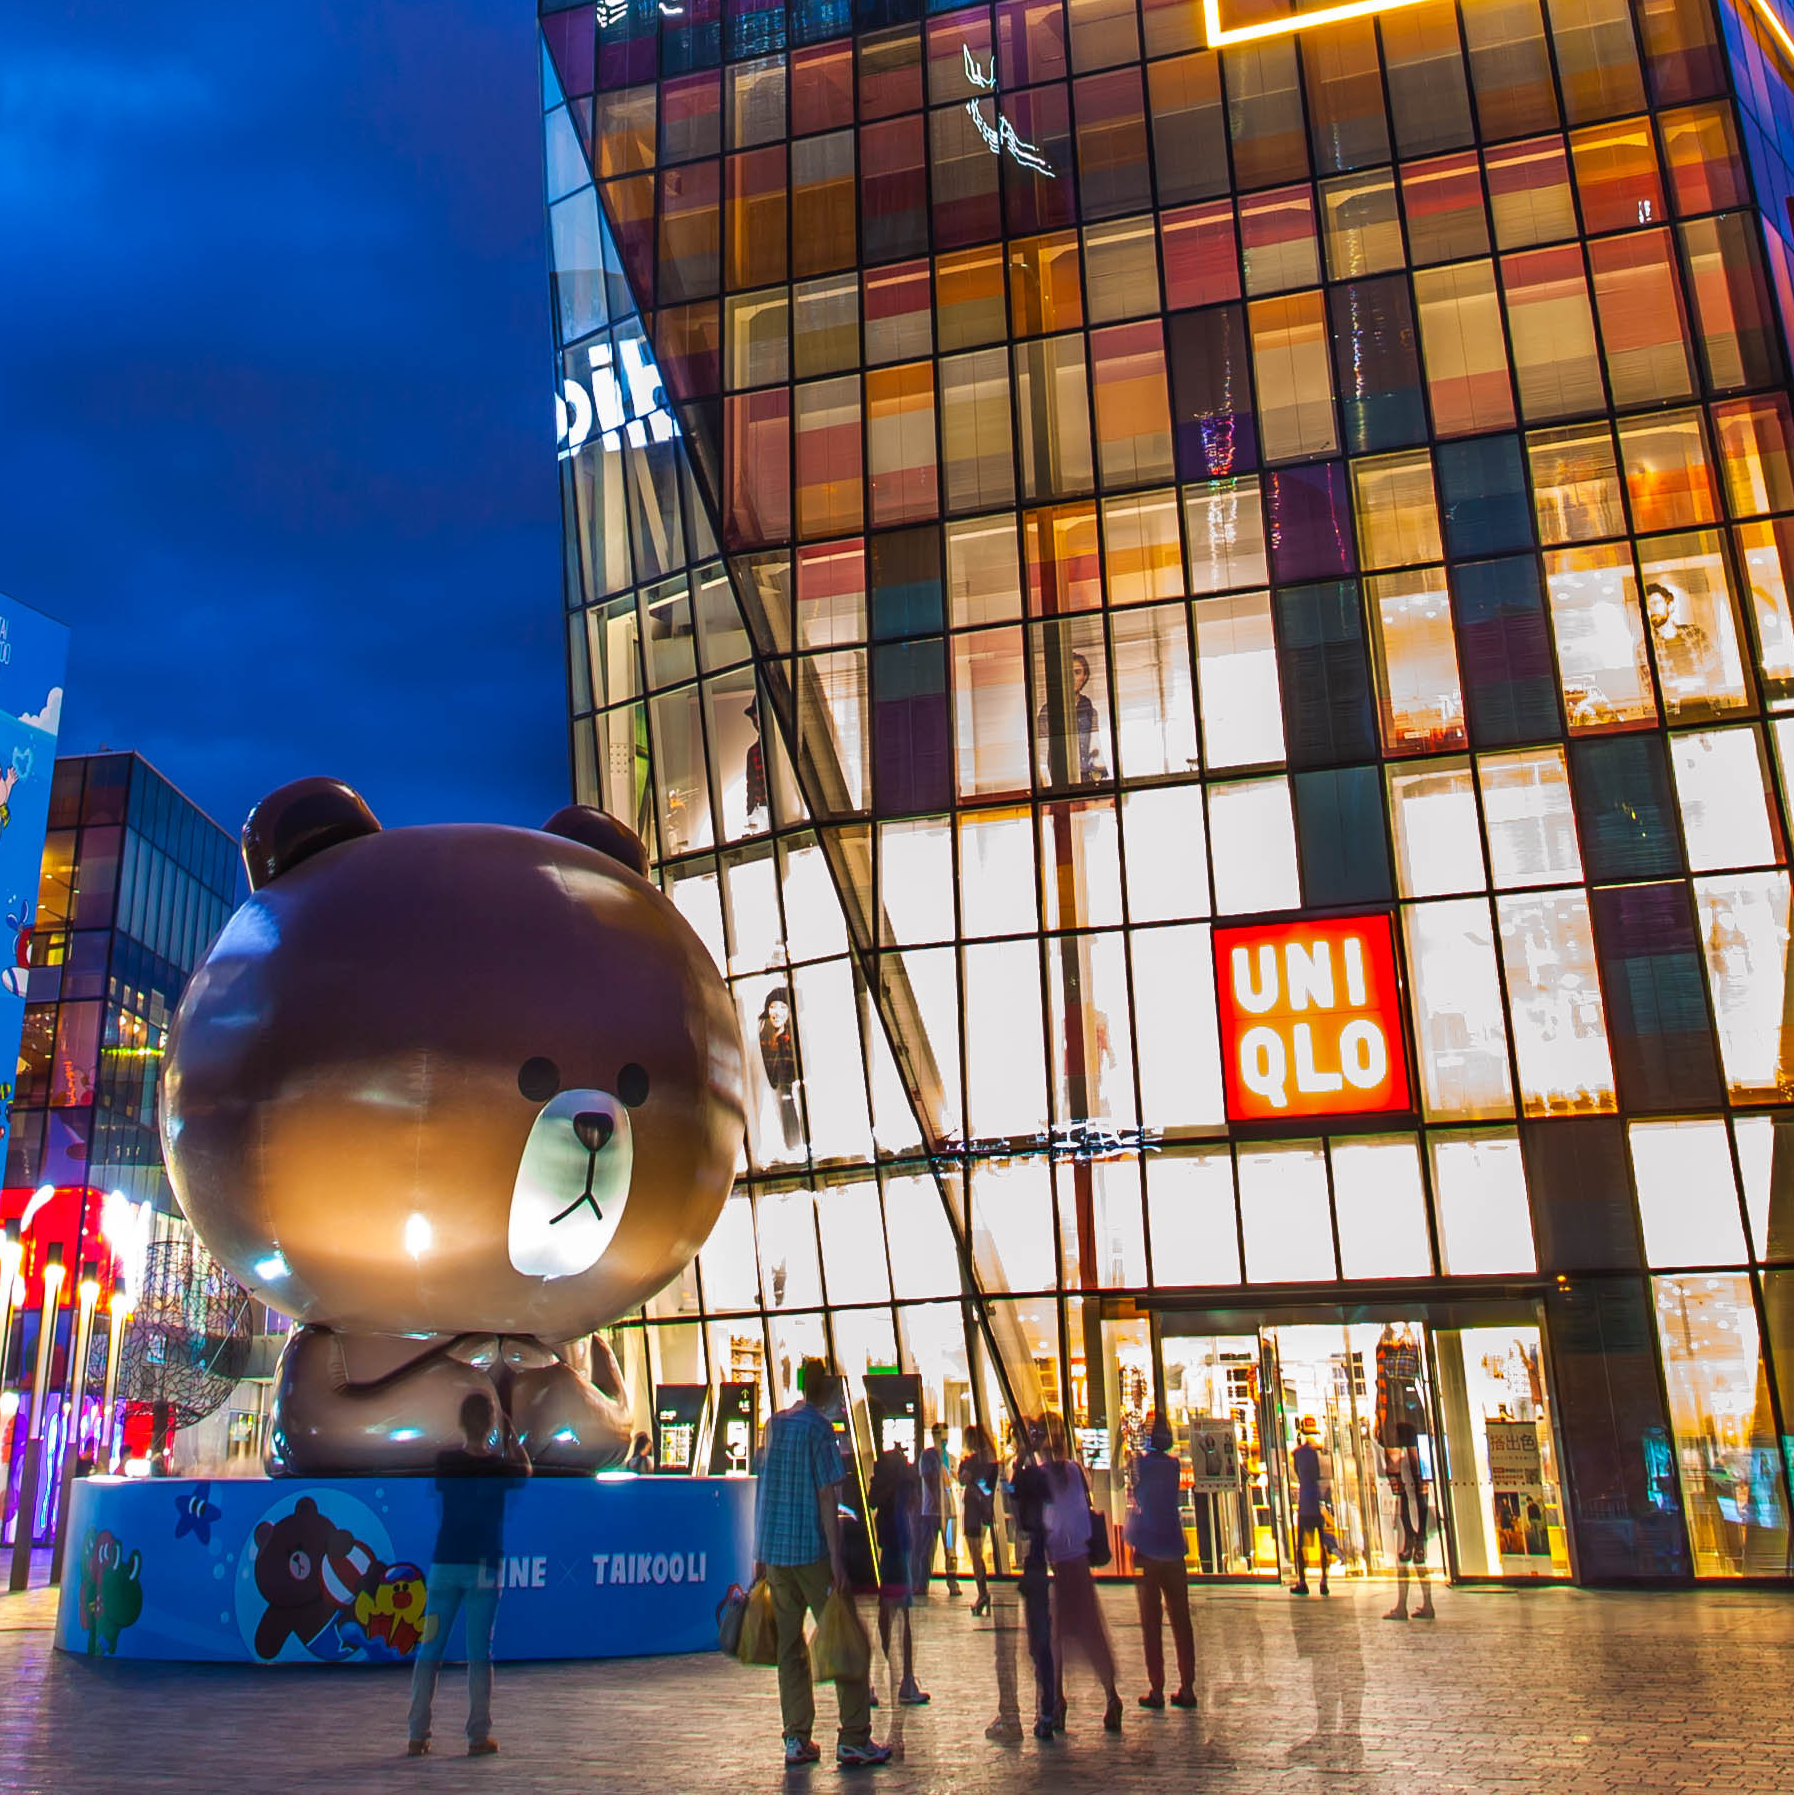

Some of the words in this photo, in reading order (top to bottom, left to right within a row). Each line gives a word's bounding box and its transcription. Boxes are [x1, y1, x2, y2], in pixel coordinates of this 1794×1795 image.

[1232, 937, 1366, 1013] UNI
[1239, 1020, 1388, 1108] QLO
[477, 1556, 547, 1589] LINE
[592, 1552, 685, 1586] TAIKOO
[687, 1552, 707, 1582] LI
